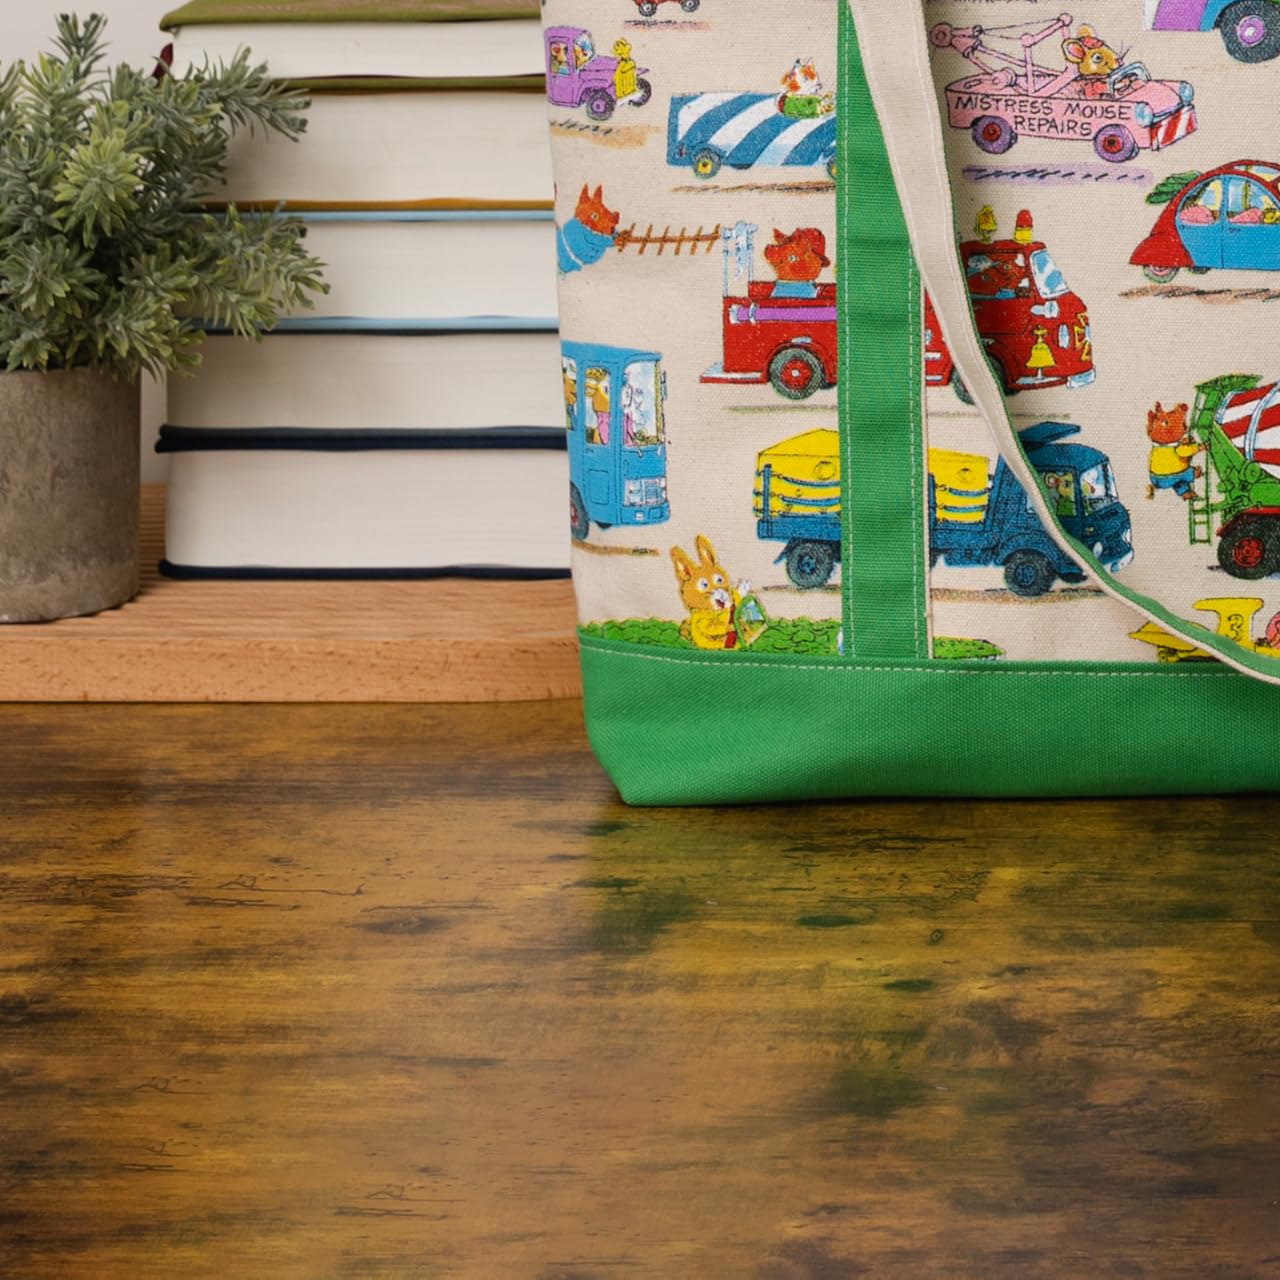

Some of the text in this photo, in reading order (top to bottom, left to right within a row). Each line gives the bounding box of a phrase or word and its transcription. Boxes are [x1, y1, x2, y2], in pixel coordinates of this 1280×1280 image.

[955, 95, 1131, 120] MISTRESS MOUSE
[1013, 115, 1092, 136] REPAIRS
